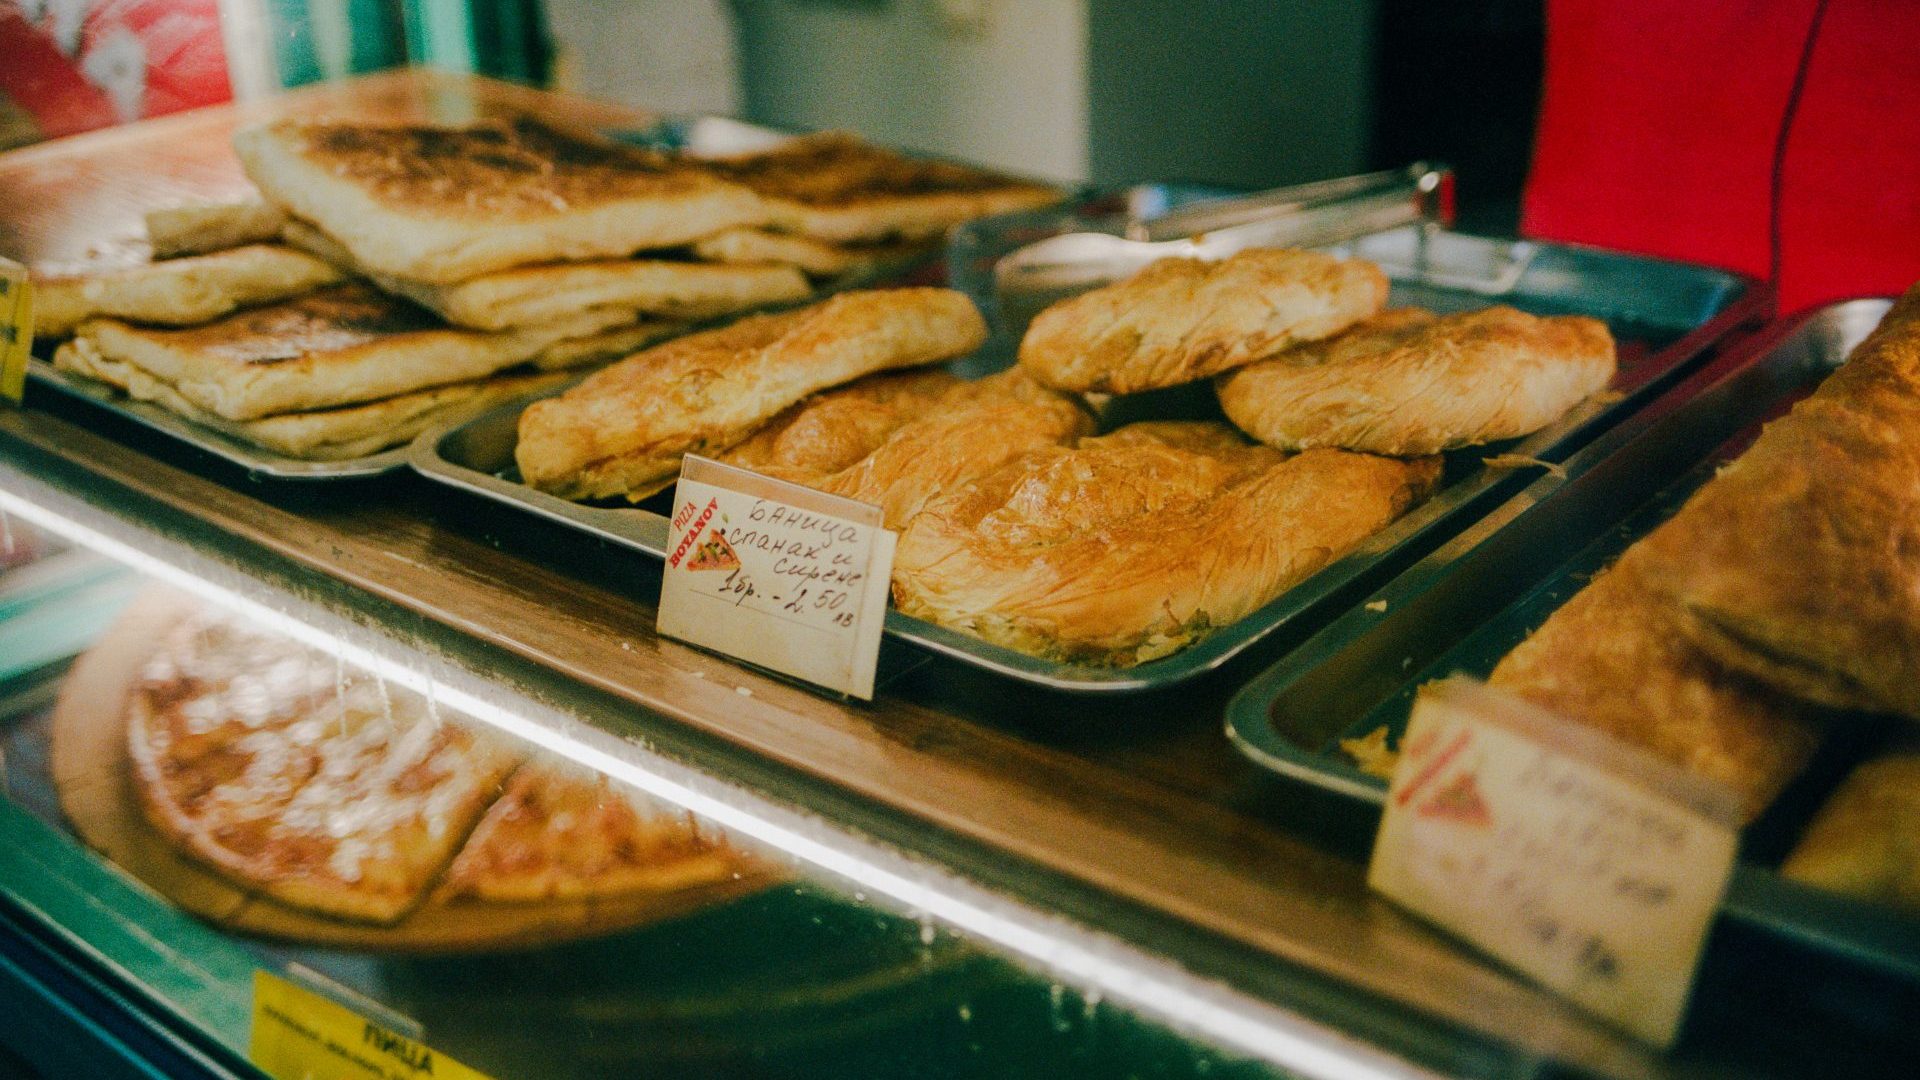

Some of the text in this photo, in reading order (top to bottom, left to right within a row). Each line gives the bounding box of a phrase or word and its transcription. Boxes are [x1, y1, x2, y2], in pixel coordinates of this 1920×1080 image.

[674, 501, 697, 532] PIZZA
[669, 497, 718, 569] BOYANOV
[832, 553, 853, 565] и
